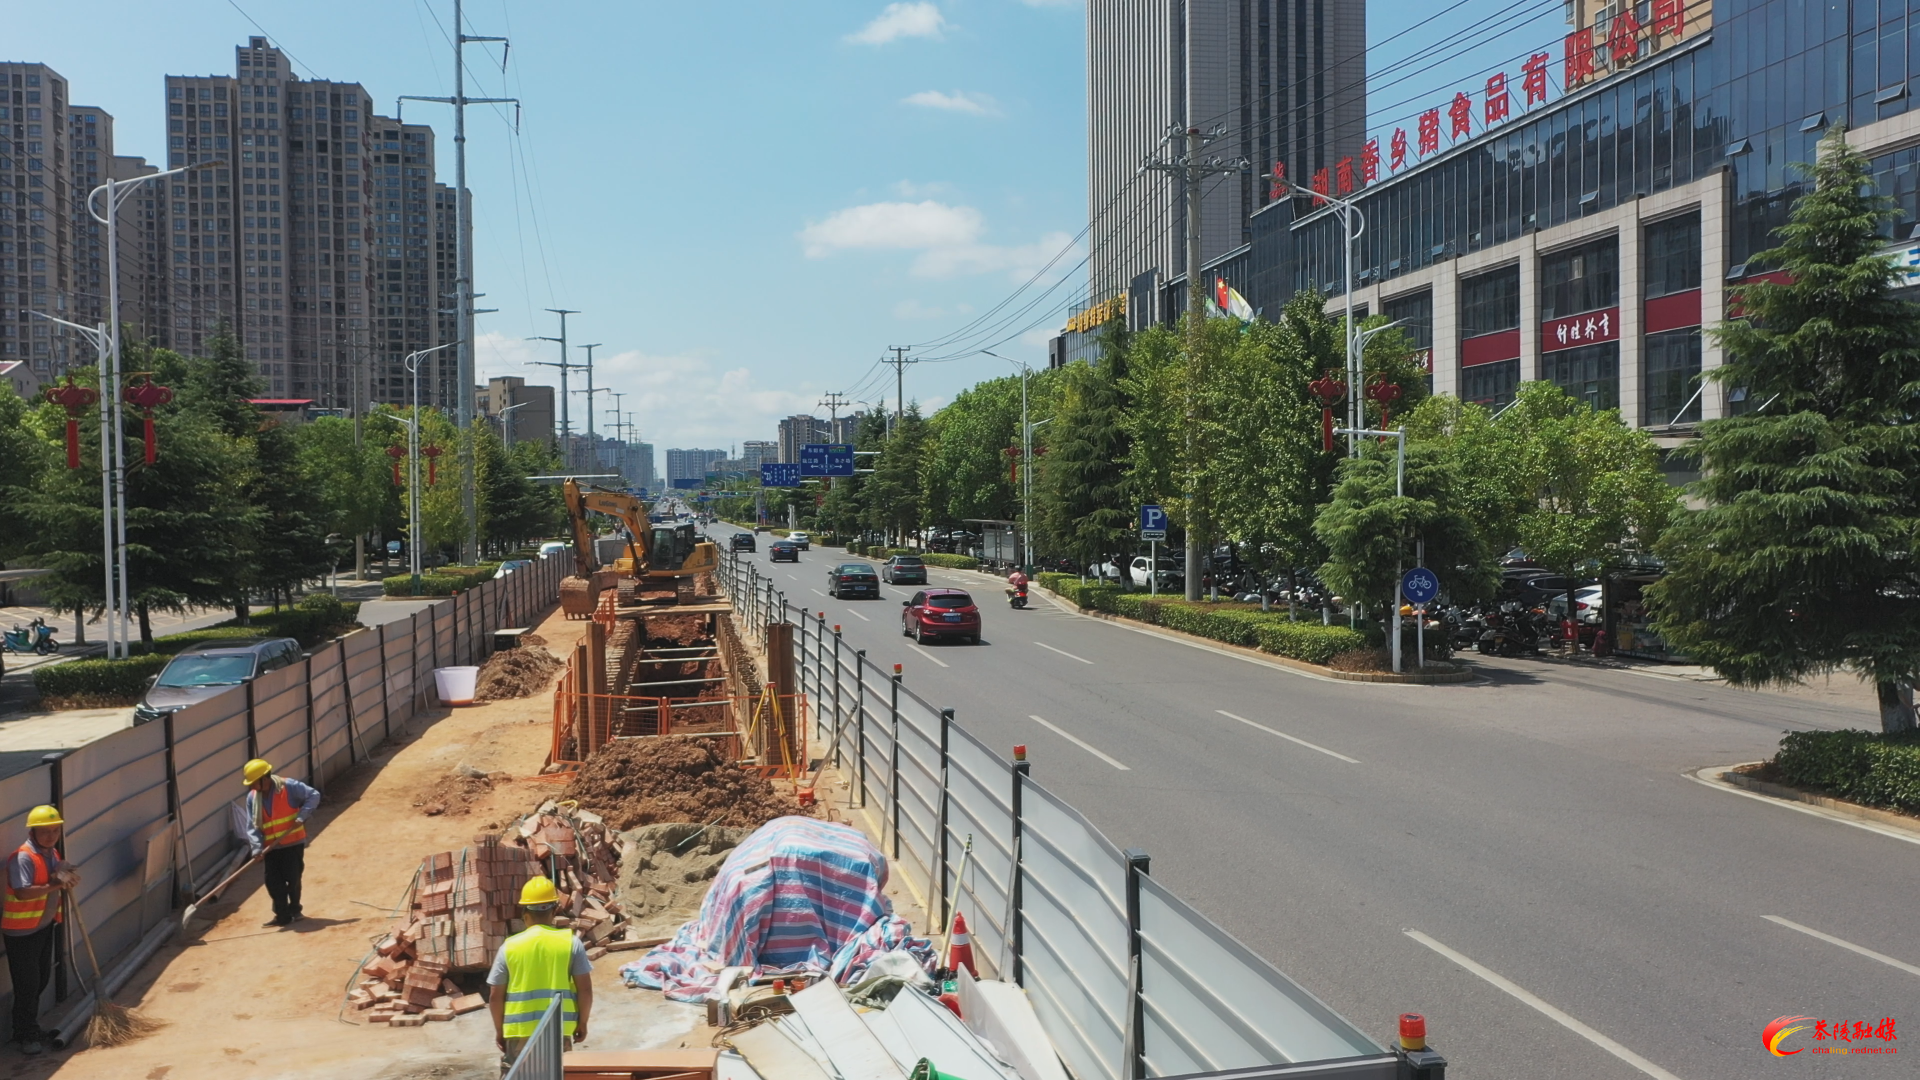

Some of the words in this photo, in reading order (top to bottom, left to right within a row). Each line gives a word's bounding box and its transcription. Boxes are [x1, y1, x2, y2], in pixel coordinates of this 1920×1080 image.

[1312, 0, 1684, 207] 湖南香乡猪食品有限公司
[1146, 508, 1162, 528] P
